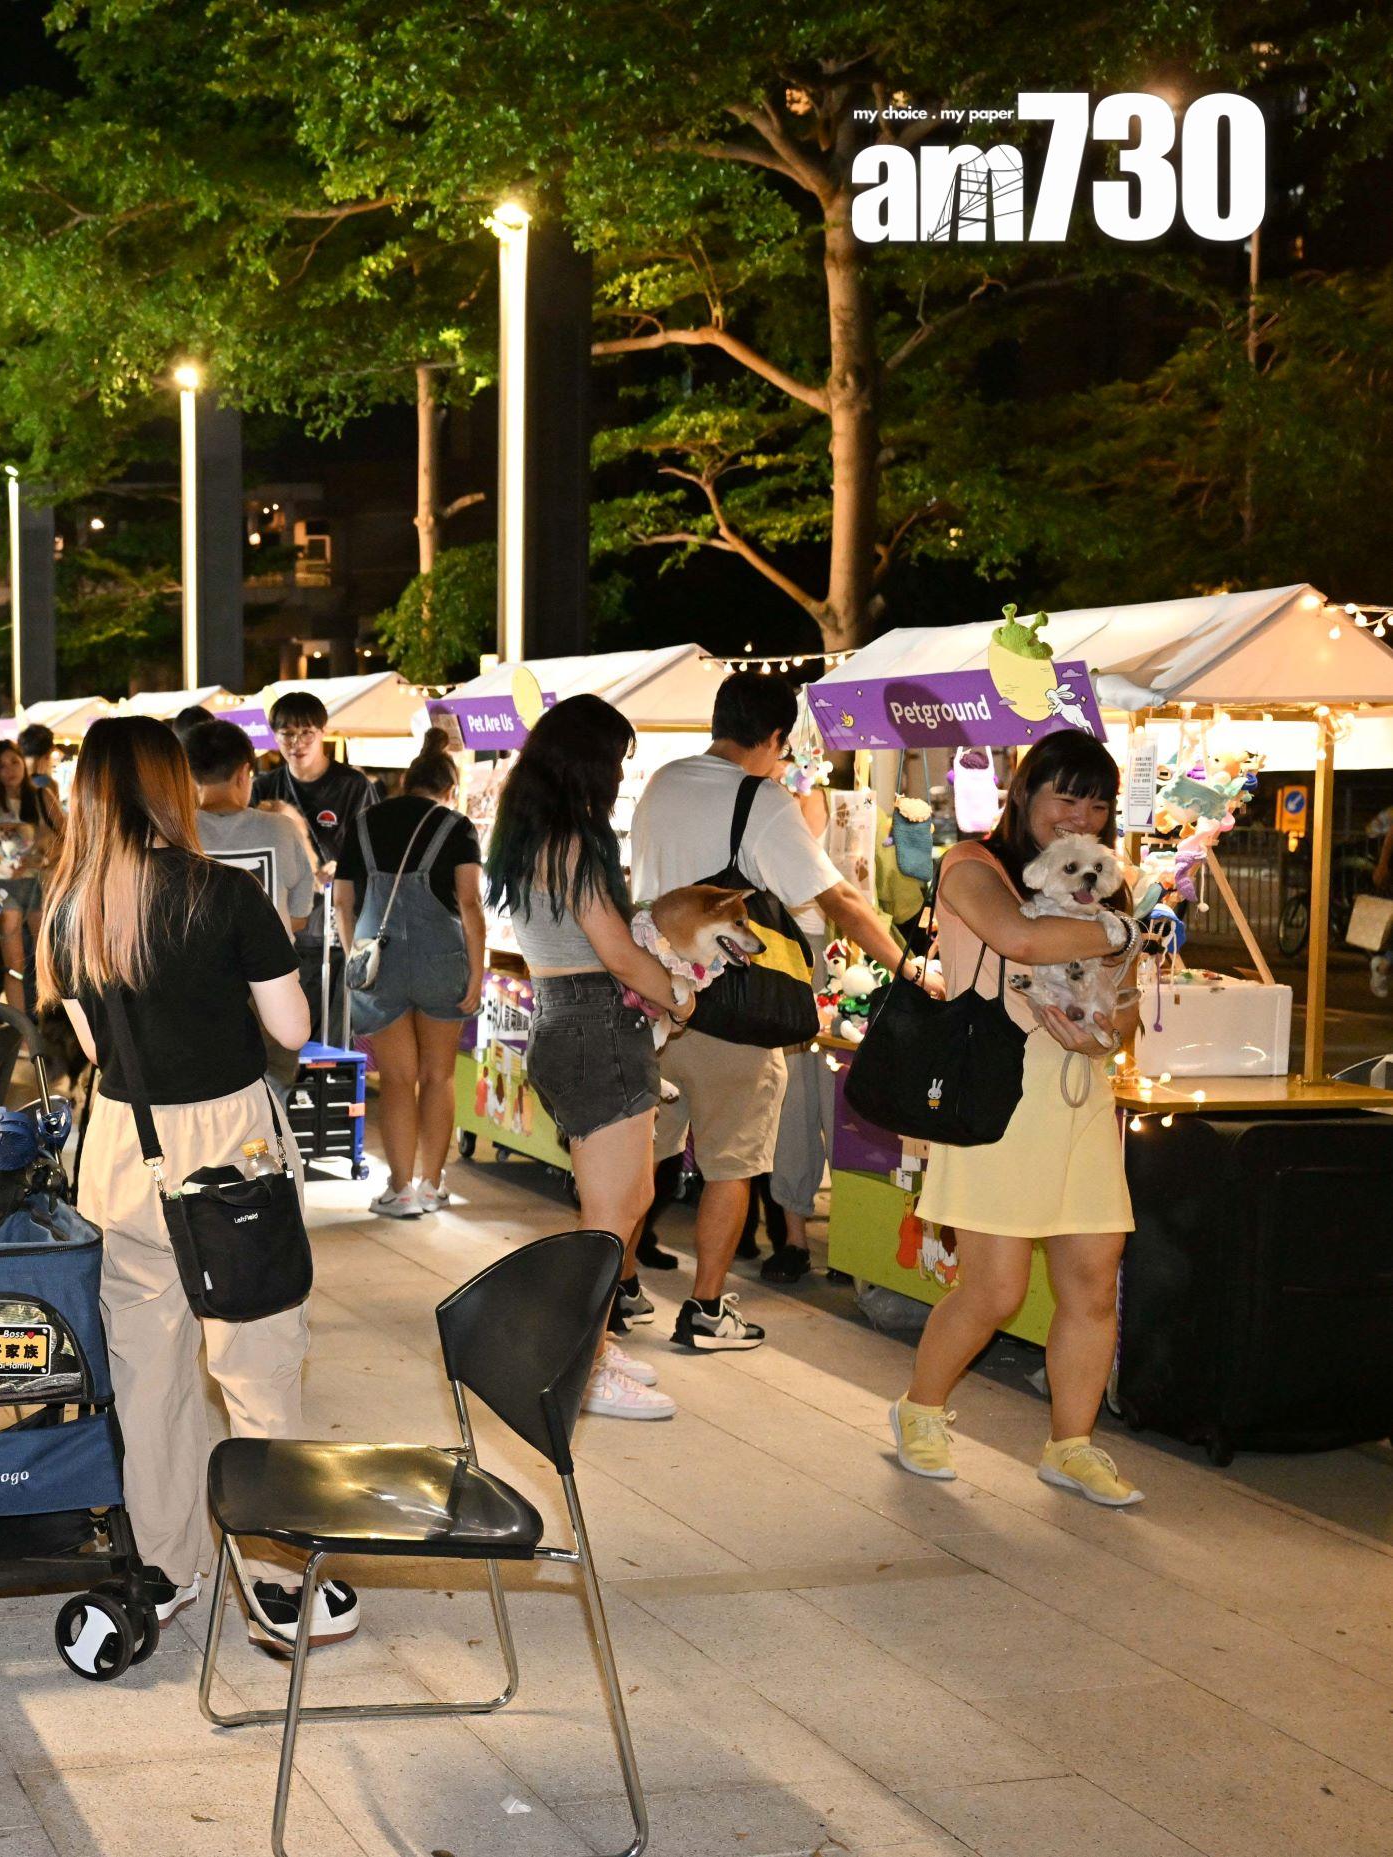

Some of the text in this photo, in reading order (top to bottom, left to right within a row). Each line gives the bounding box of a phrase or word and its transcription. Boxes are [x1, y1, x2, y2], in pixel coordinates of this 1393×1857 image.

[889, 693, 992, 730] Petground
[467, 713, 515, 733] Pet Are Us
[3, 1329, 25, 1339] Boss
